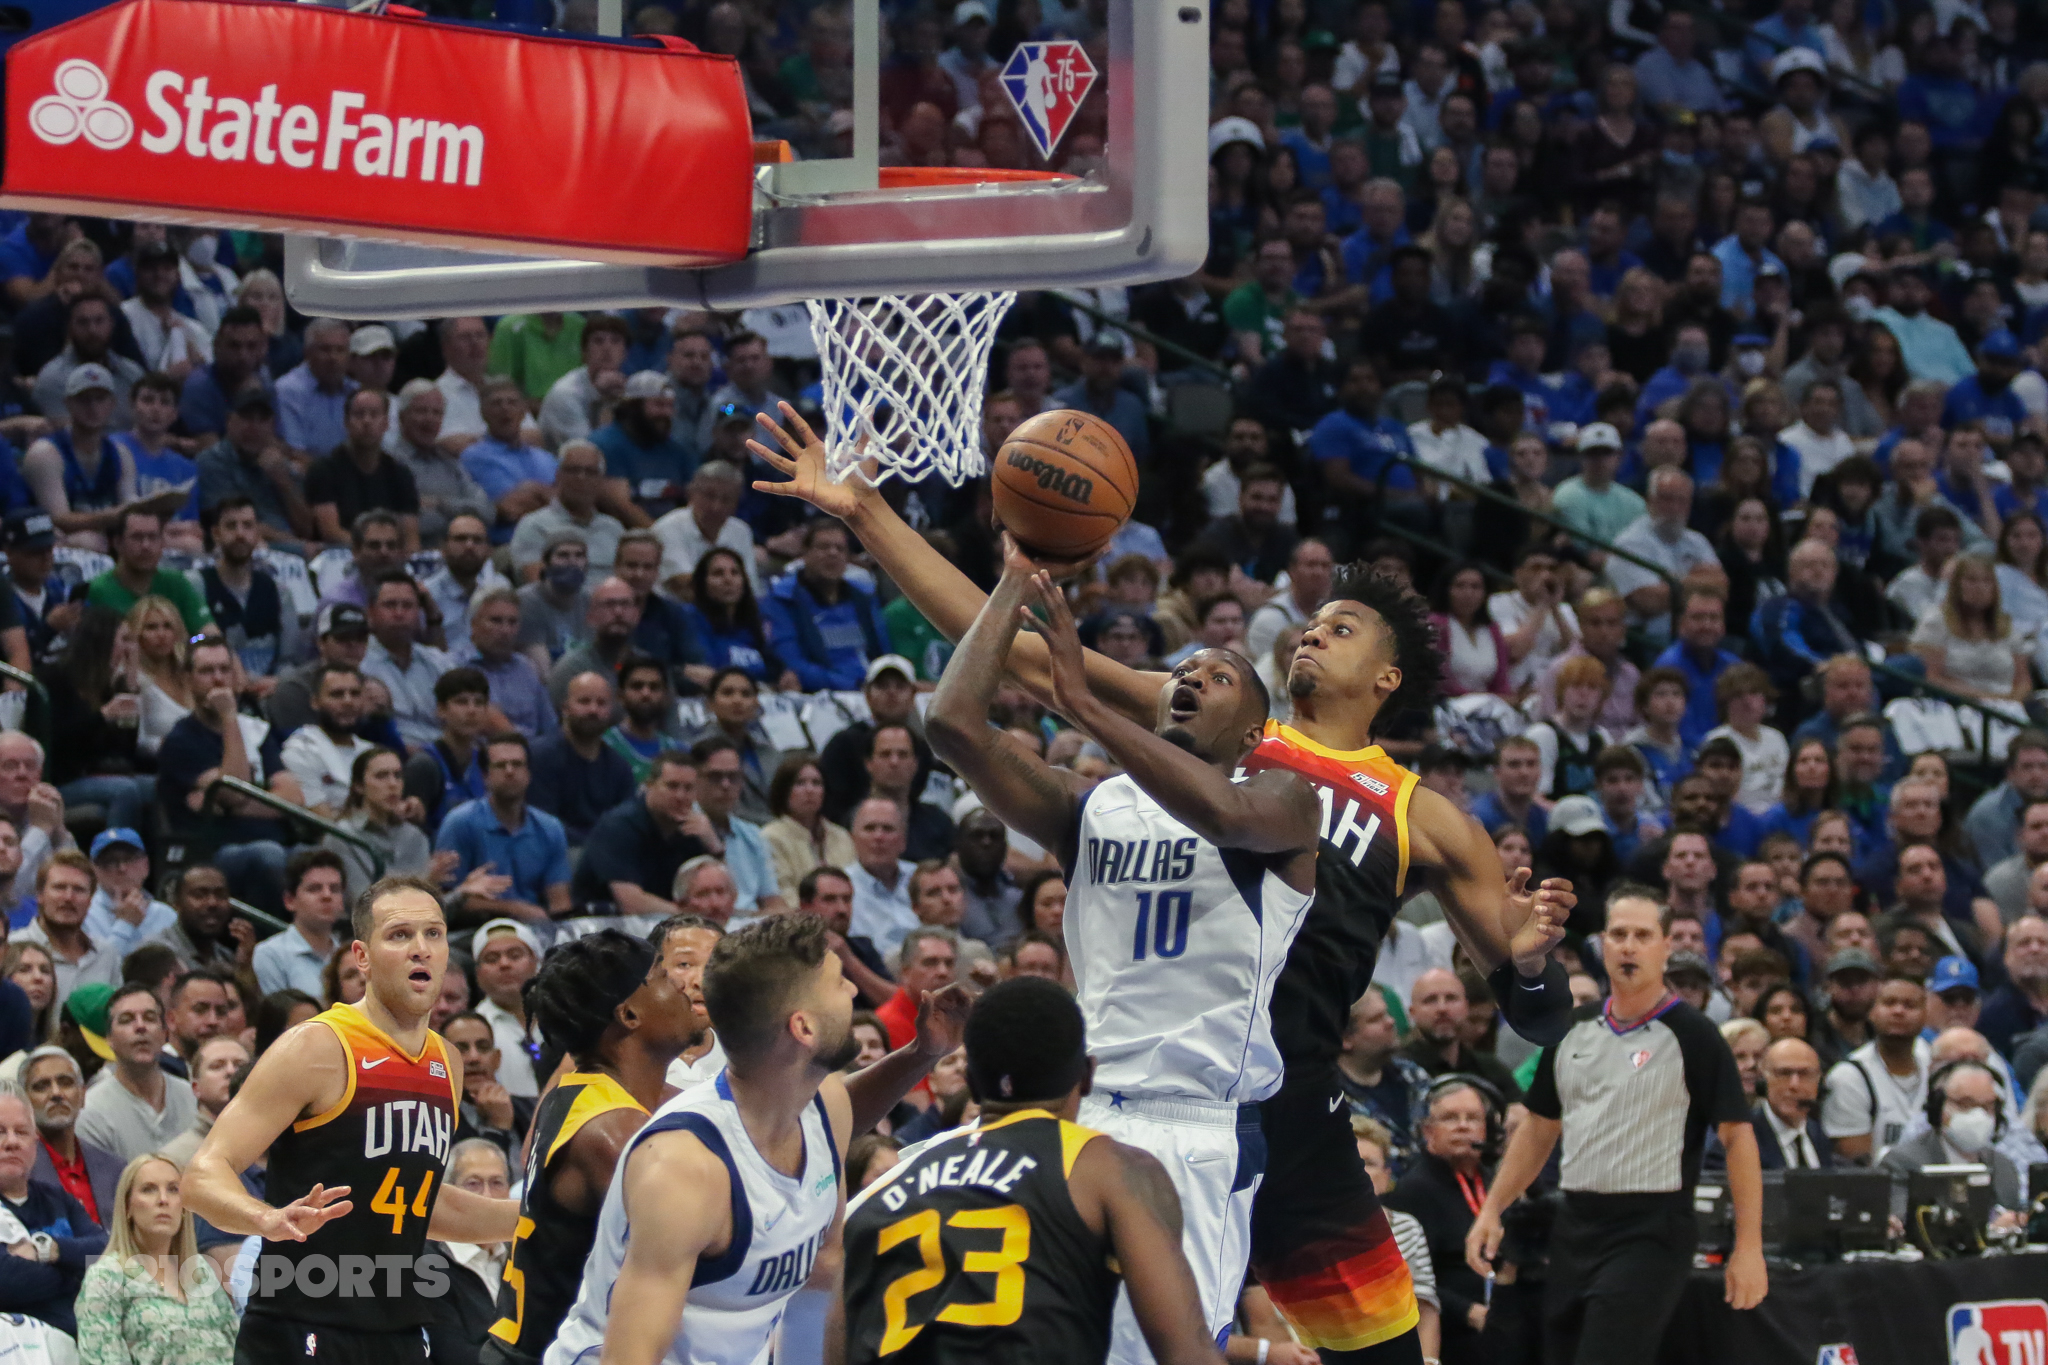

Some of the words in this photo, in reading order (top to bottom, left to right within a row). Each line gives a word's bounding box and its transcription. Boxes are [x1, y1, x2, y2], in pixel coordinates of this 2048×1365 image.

[1056, 58, 1076, 93] 75
[1007, 448, 1094, 506] Wilson
[1088, 837, 1200, 887] DALLAS
[1132, 890, 1193, 962] 10
[365, 1100, 451, 1167] UTAH
[370, 1167, 434, 1235] 44
[882, 1149, 1038, 1212] O'NEALE
[746, 1224, 828, 1296] DALL
[877, 1204, 1032, 1358] 23
[1999, 1330, 2046, 1365] TV
